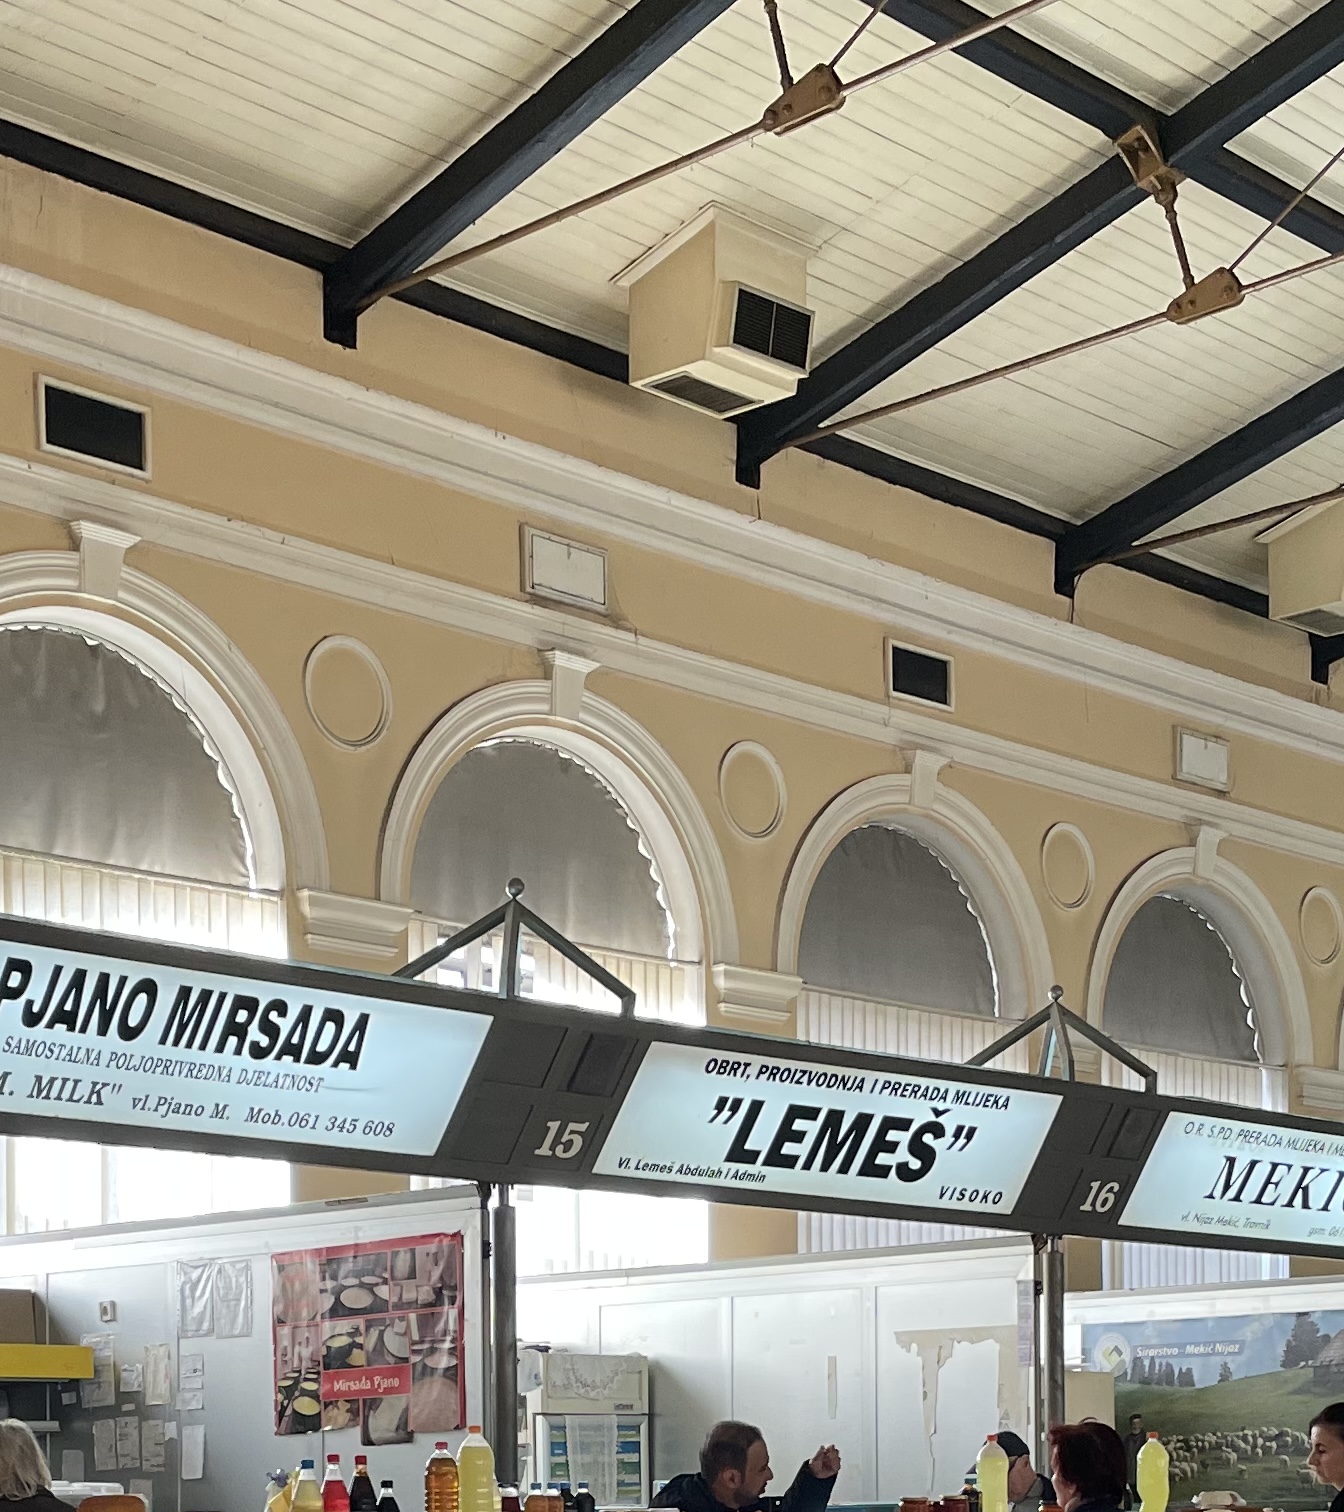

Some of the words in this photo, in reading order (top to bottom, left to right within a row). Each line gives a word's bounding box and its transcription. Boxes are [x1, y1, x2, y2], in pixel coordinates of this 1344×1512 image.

[157, 983, 371, 1072] MIRSADA
[2, 1035, 102, 1067] SAMOSTALNA
[106, 1051, 233, 1084] POLJOPRIVREDNA
[236, 1068, 325, 1093] DJELATNOST
[704, 1057, 752, 1083] OBRT,
[755, 1063, 866, 1094] PROIZVODNJA
[869, 1078, 880, 1095] I
[878, 1079, 949, 1104] PRERADA
[950, 1089, 1011, 1111] MLIJEKA
[26, 1073, 123, 1106] MILK"
[209, 1102, 230, 1121] M.
[325, 1116, 359, 1135] 345
[362, 1119, 396, 1138] 608
[533, 1118, 591, 1160] 15
[1236, 1129, 1283, 1148] PRERADA
[634, 1158, 674, 1175] Lemeš
[730, 1169, 766, 1184] Admin
[938, 1185, 1004, 1205] VISOKO
[1079, 1179, 1120, 1214] 16
[1185, 1343, 1214, 1355] Mekić
[1214, 1342, 1241, 1355] Nijaz
[333, 1376, 372, 1393] Mirsada
[373, 1375, 400, 1393] Pjano
